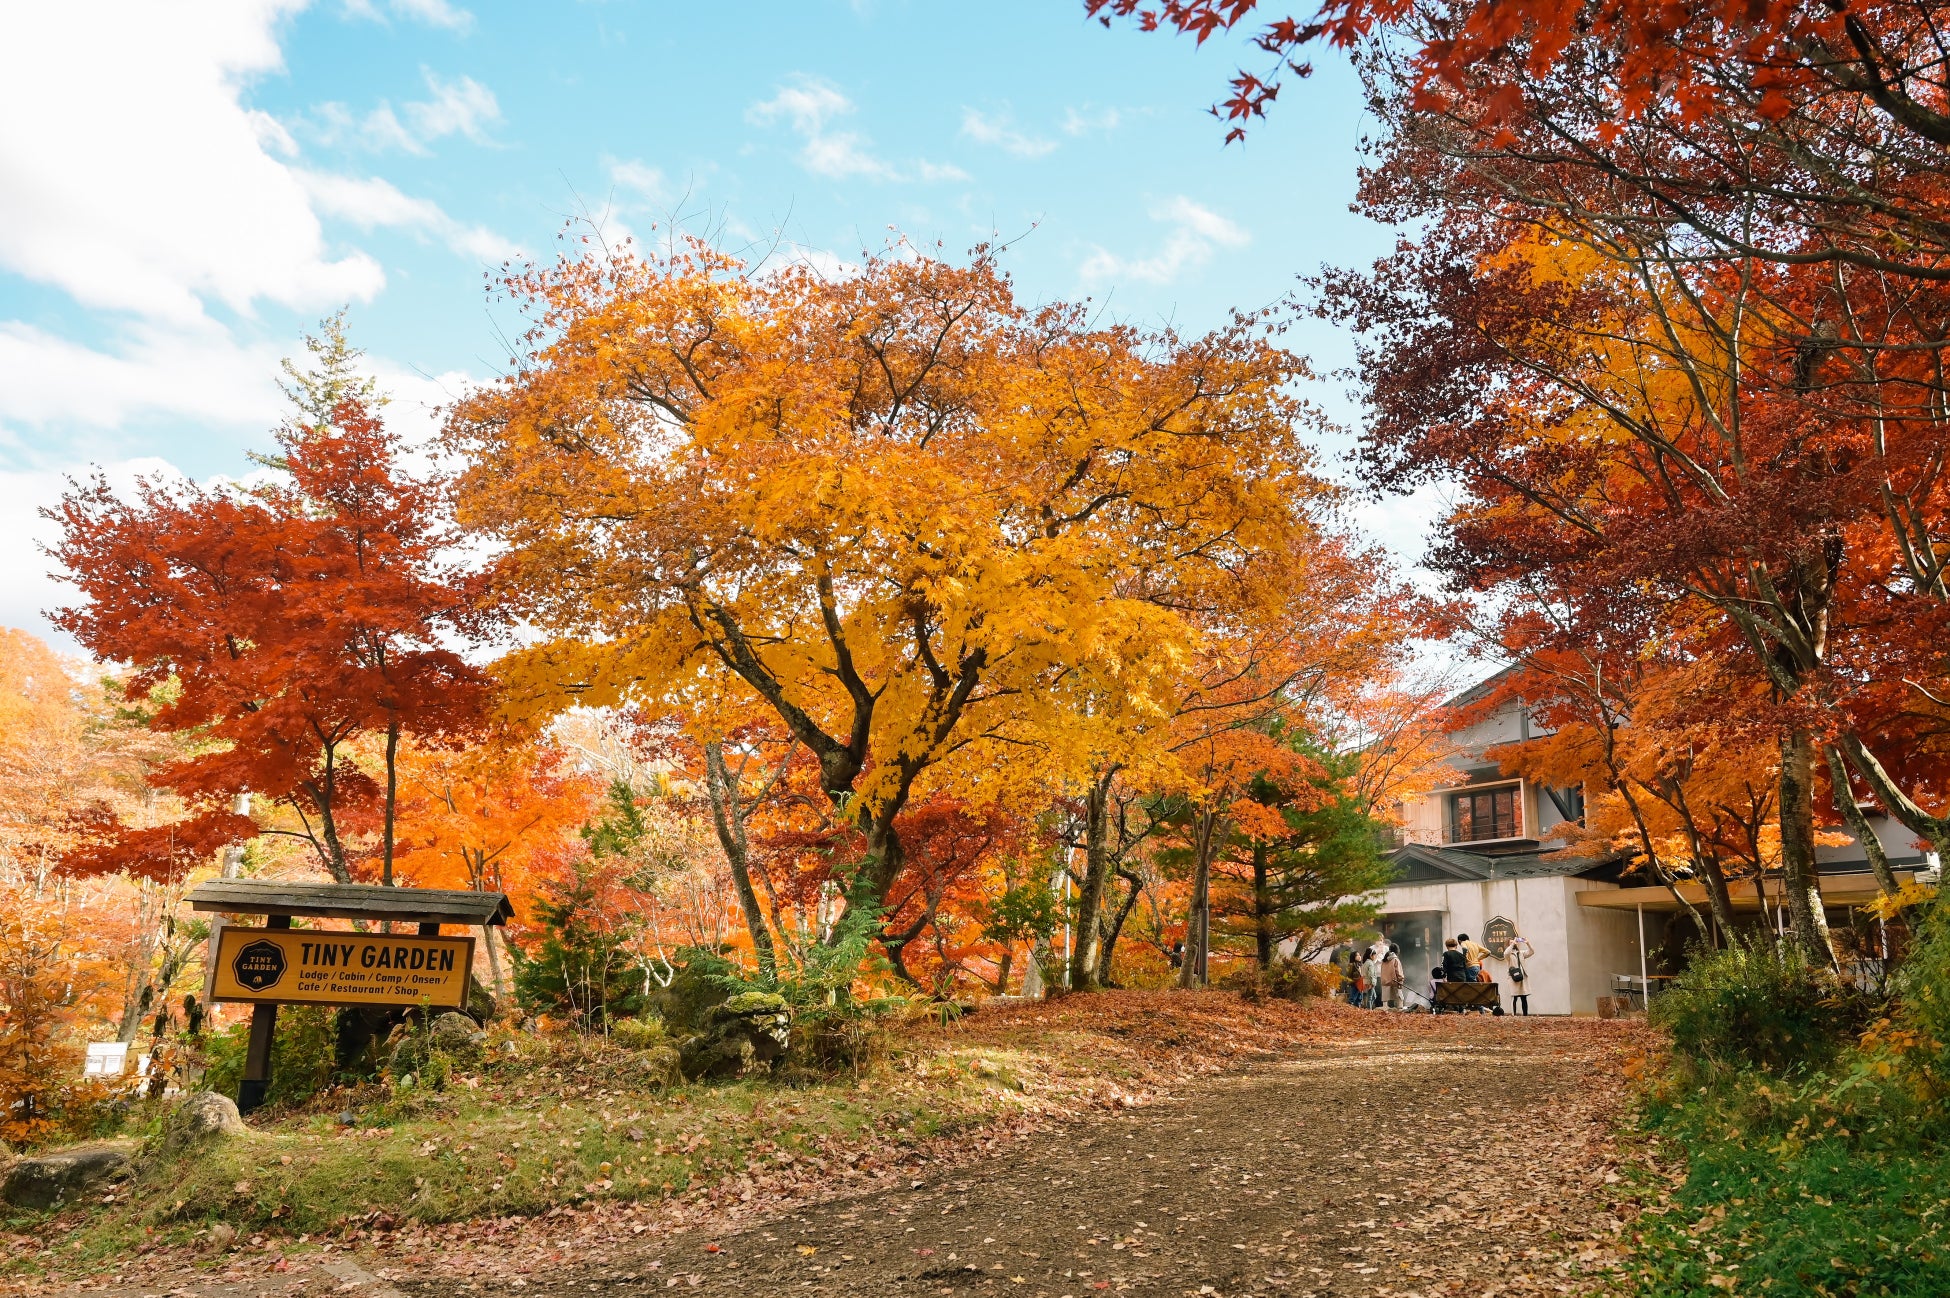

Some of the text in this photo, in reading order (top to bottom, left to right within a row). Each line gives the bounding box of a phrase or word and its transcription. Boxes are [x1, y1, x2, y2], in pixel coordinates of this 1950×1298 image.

[301, 943, 454, 971] TINY GARDEN
[300, 970, 328, 981] Lodge
[339, 972, 365, 981] Cabin
[376, 973, 402, 984] Camp
[412, 975, 440, 984] Onsen
[298, 982, 320, 991] Cafe
[330, 984, 384, 994] Restaurant
[394, 986, 419, 997] Shop
